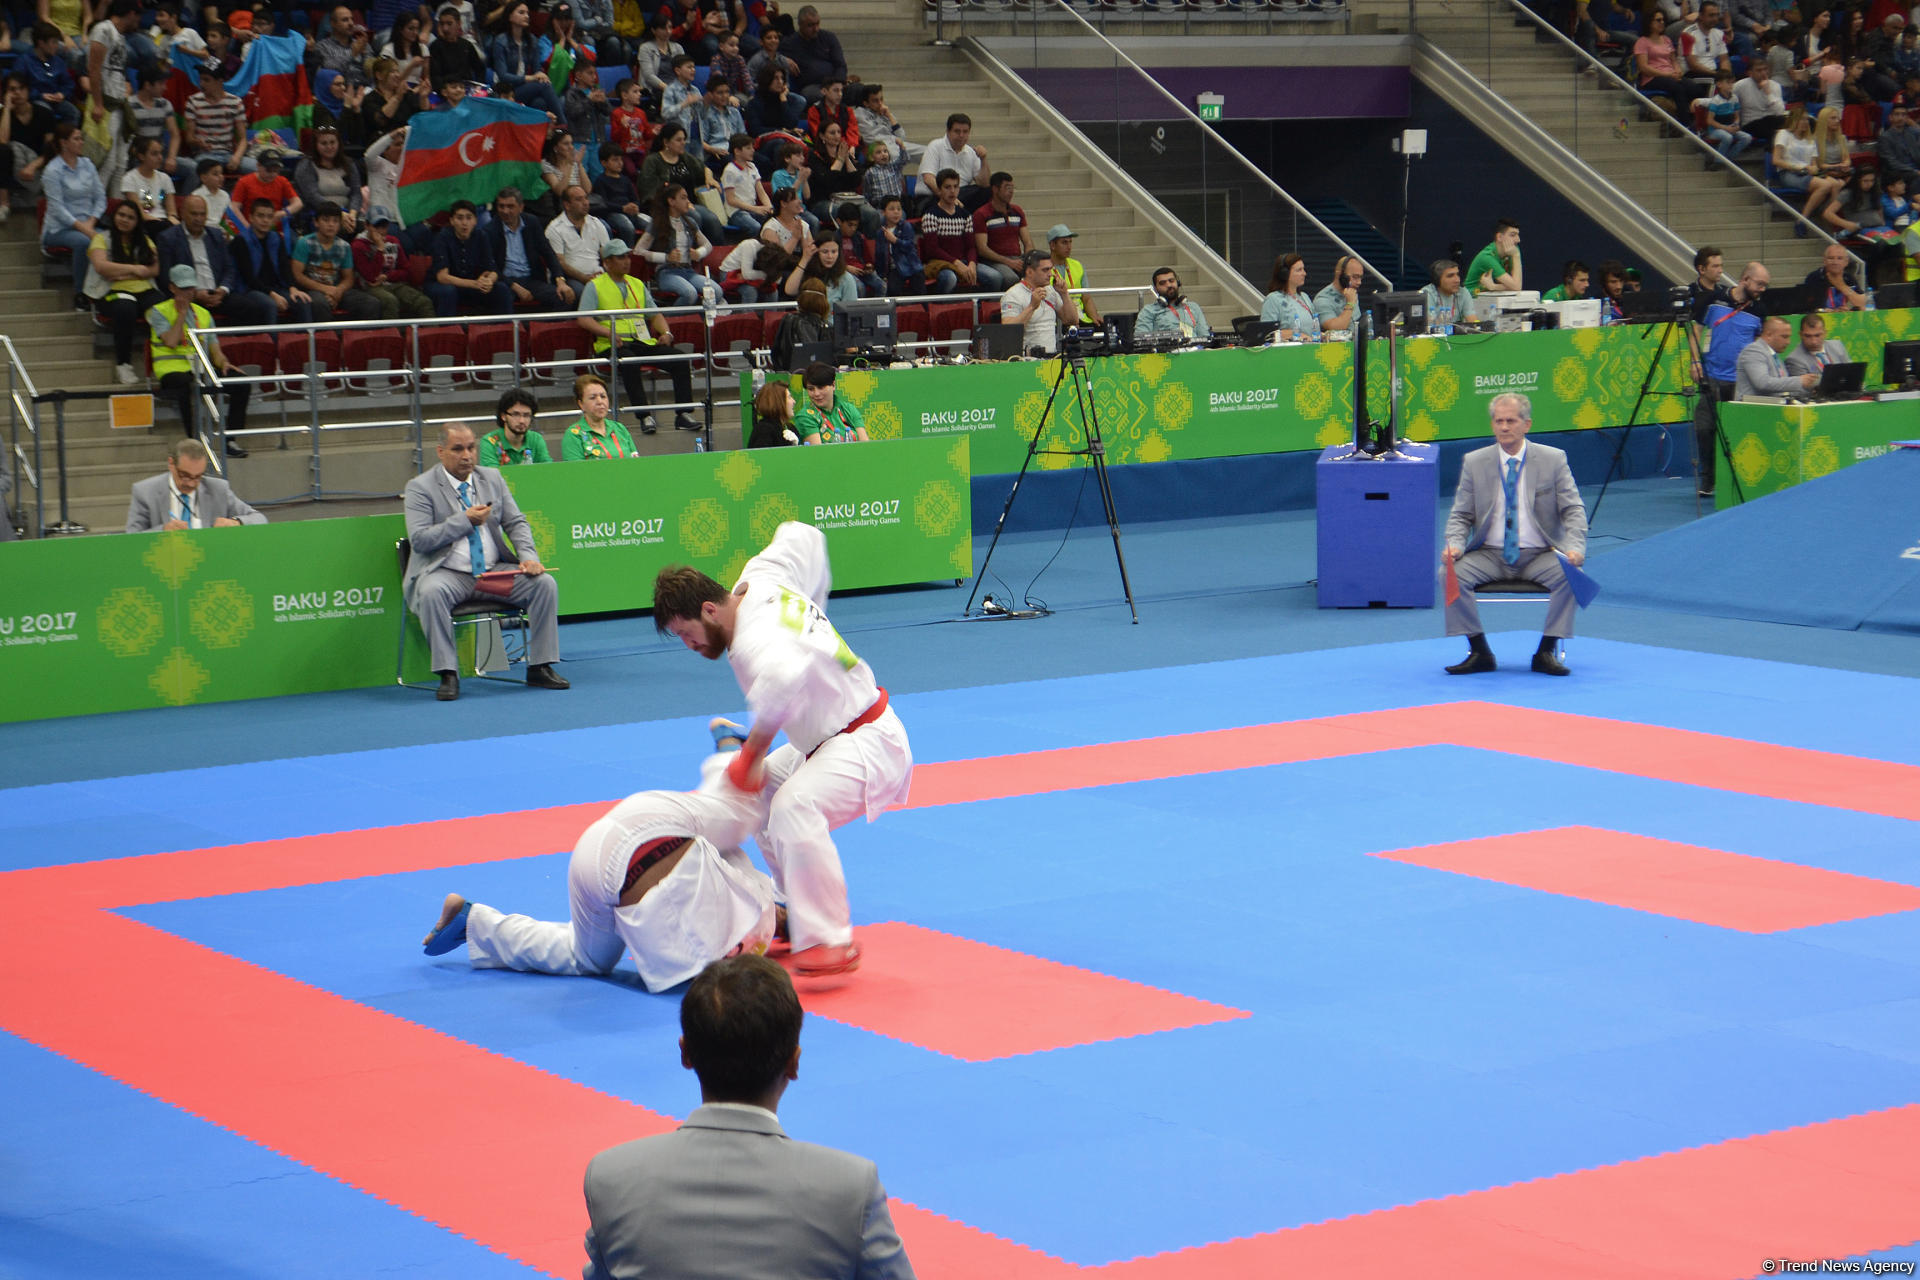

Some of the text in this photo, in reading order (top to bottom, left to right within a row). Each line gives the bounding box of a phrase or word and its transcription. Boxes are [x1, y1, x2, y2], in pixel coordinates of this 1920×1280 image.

[1475, 371, 1538, 387] BAKU 2017
[1209, 388, 1278, 405] BAKU 2017
[921, 408, 996, 425] BAKU 2017
[814, 499, 900, 521] BAKU 2017
[571, 518, 664, 539] BAKU 2017
[825, 521, 848, 529] Islamic
[848, 518, 878, 526] Solidarity
[584, 540, 608, 548] Islamic
[608, 537, 640, 546] Solidarity
[641, 536, 664, 544] Games
[273, 586, 384, 611] BAKU 2017
[21, 612, 77, 633] 2017
[289, 613, 316, 621] Islamic
[318, 609, 356, 619] Solidarity
[358, 607, 385, 616] Games
